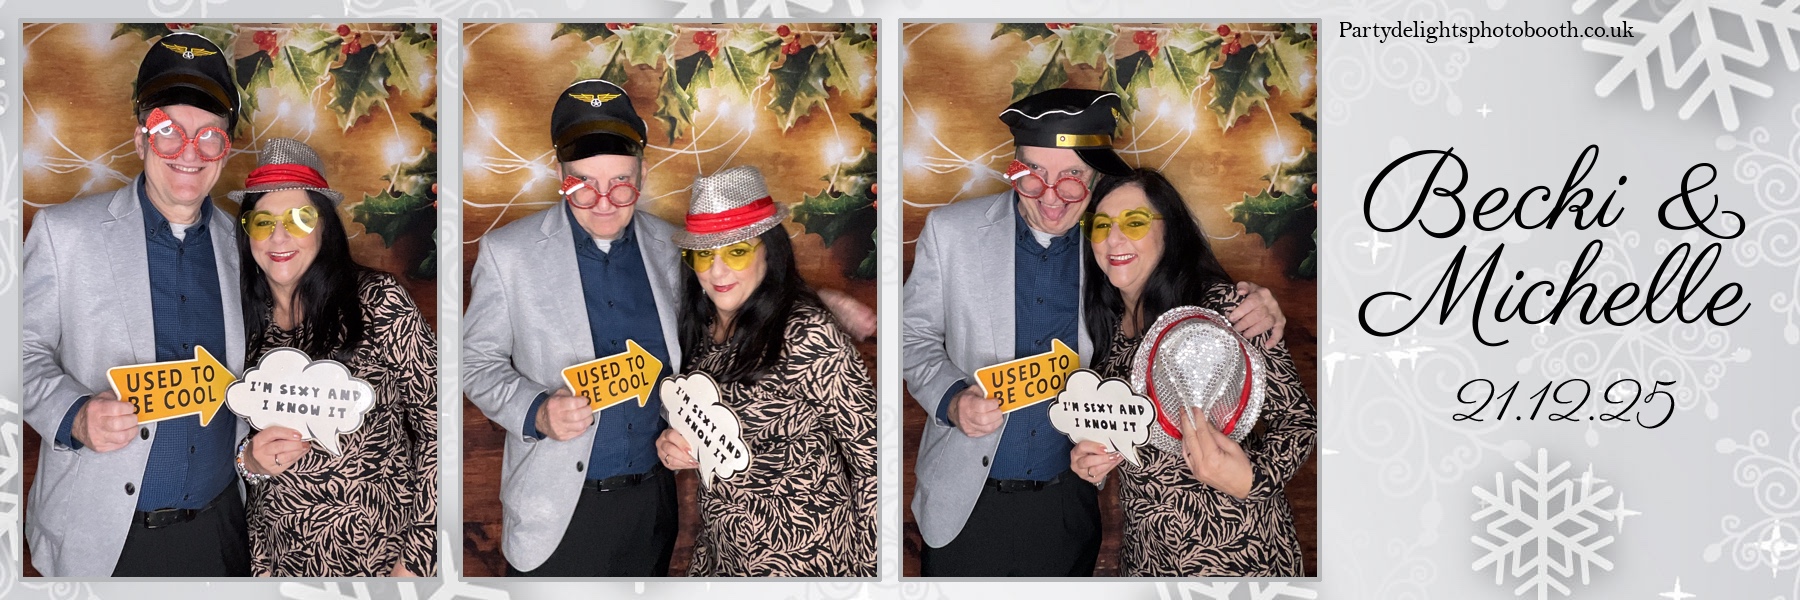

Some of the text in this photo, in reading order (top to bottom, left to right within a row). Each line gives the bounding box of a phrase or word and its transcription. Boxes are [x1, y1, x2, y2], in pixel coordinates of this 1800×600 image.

[127, 365, 215, 393] USED TO
[577, 355, 645, 387] USED TO
[992, 354, 1069, 388] USED TO
[250, 381, 361, 402] I'M SEXY AND
[608, 372, 649, 397] COOL
[994, 387, 1016, 407] BE
[128, 385, 217, 414] BE COOL
[262, 400, 346, 419] I KNOW IT
[1063, 401, 1145, 416] I'M SEXY AND
[675, 386, 742, 459] I'M SEXY AND
[677, 406, 727, 464] I KNOW IT
[1075, 418, 1137, 432] I KNOW IT
